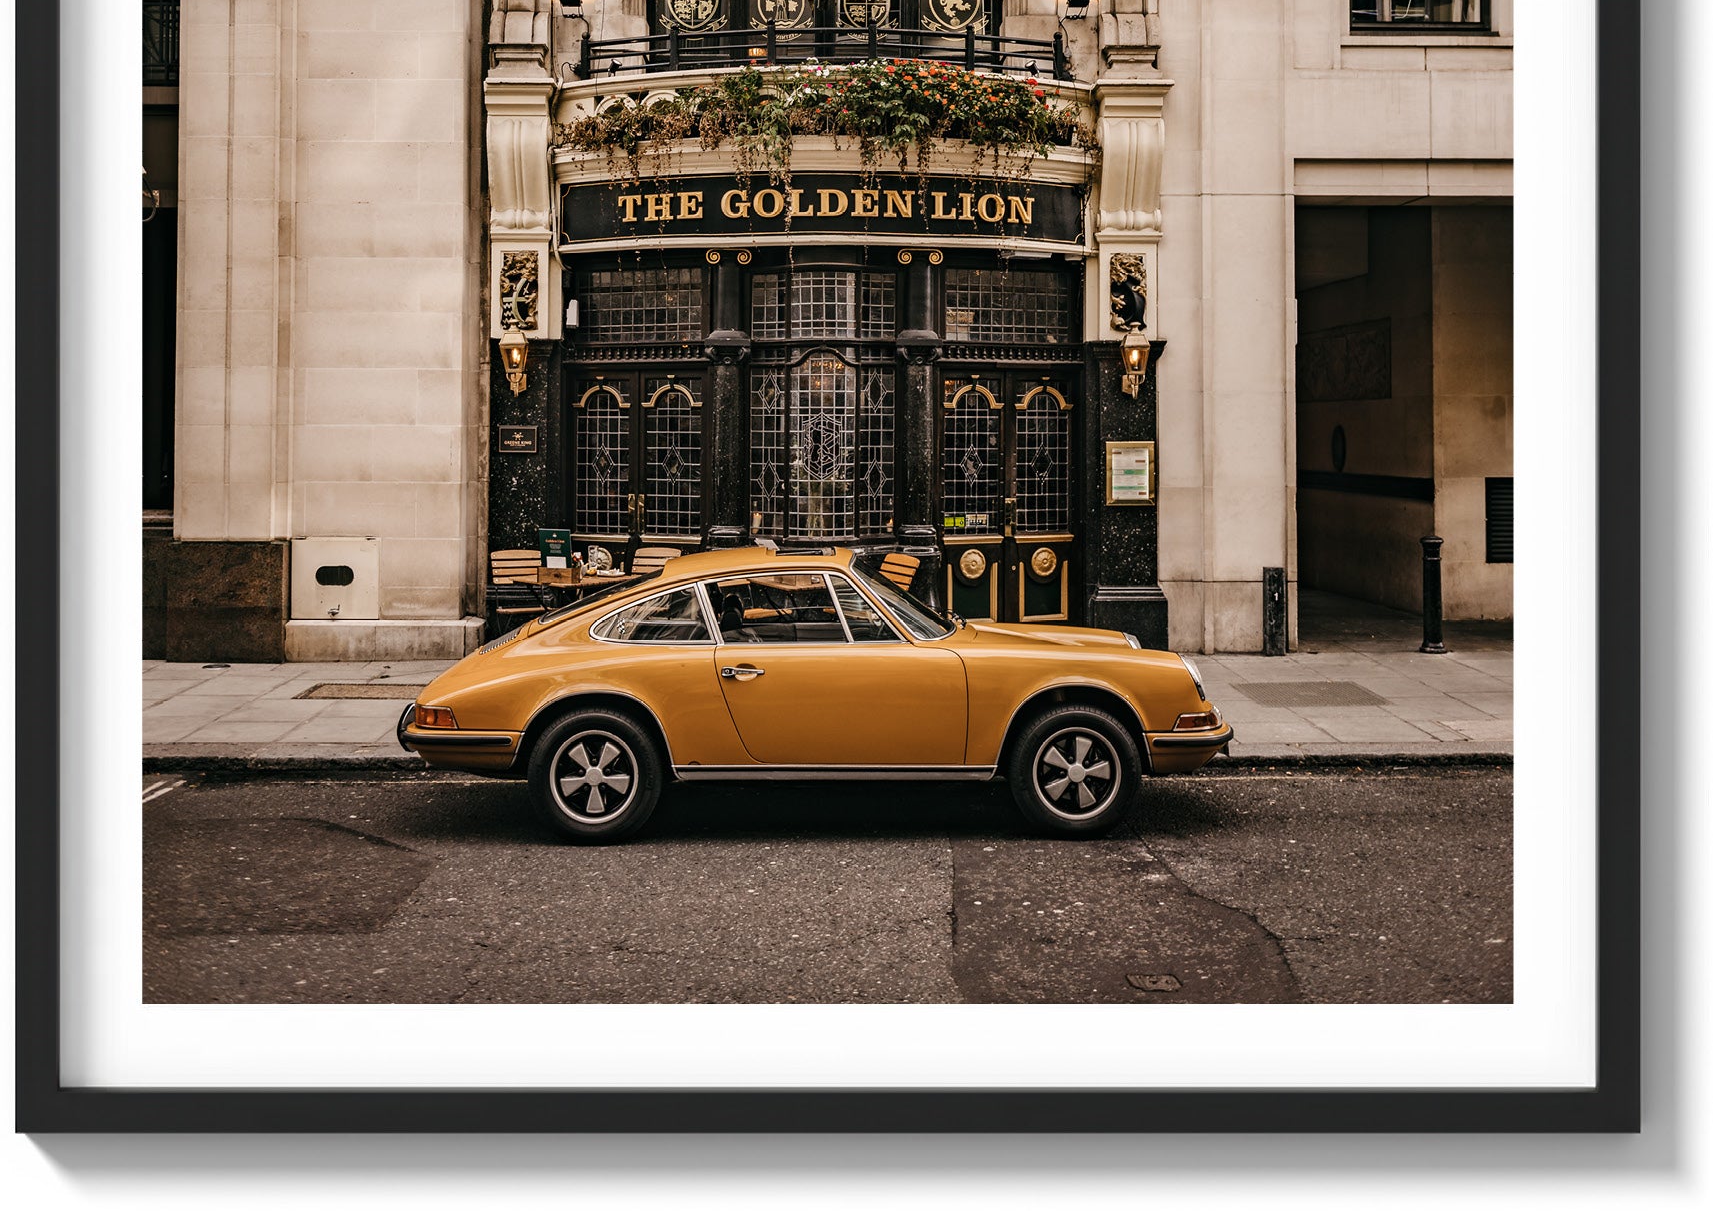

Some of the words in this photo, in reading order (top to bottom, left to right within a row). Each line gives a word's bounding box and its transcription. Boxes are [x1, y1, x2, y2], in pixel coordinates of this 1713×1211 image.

[617, 191, 704, 223] THE
[720, 188, 915, 219] GOLDEN
[930, 191, 1036, 225] LION
